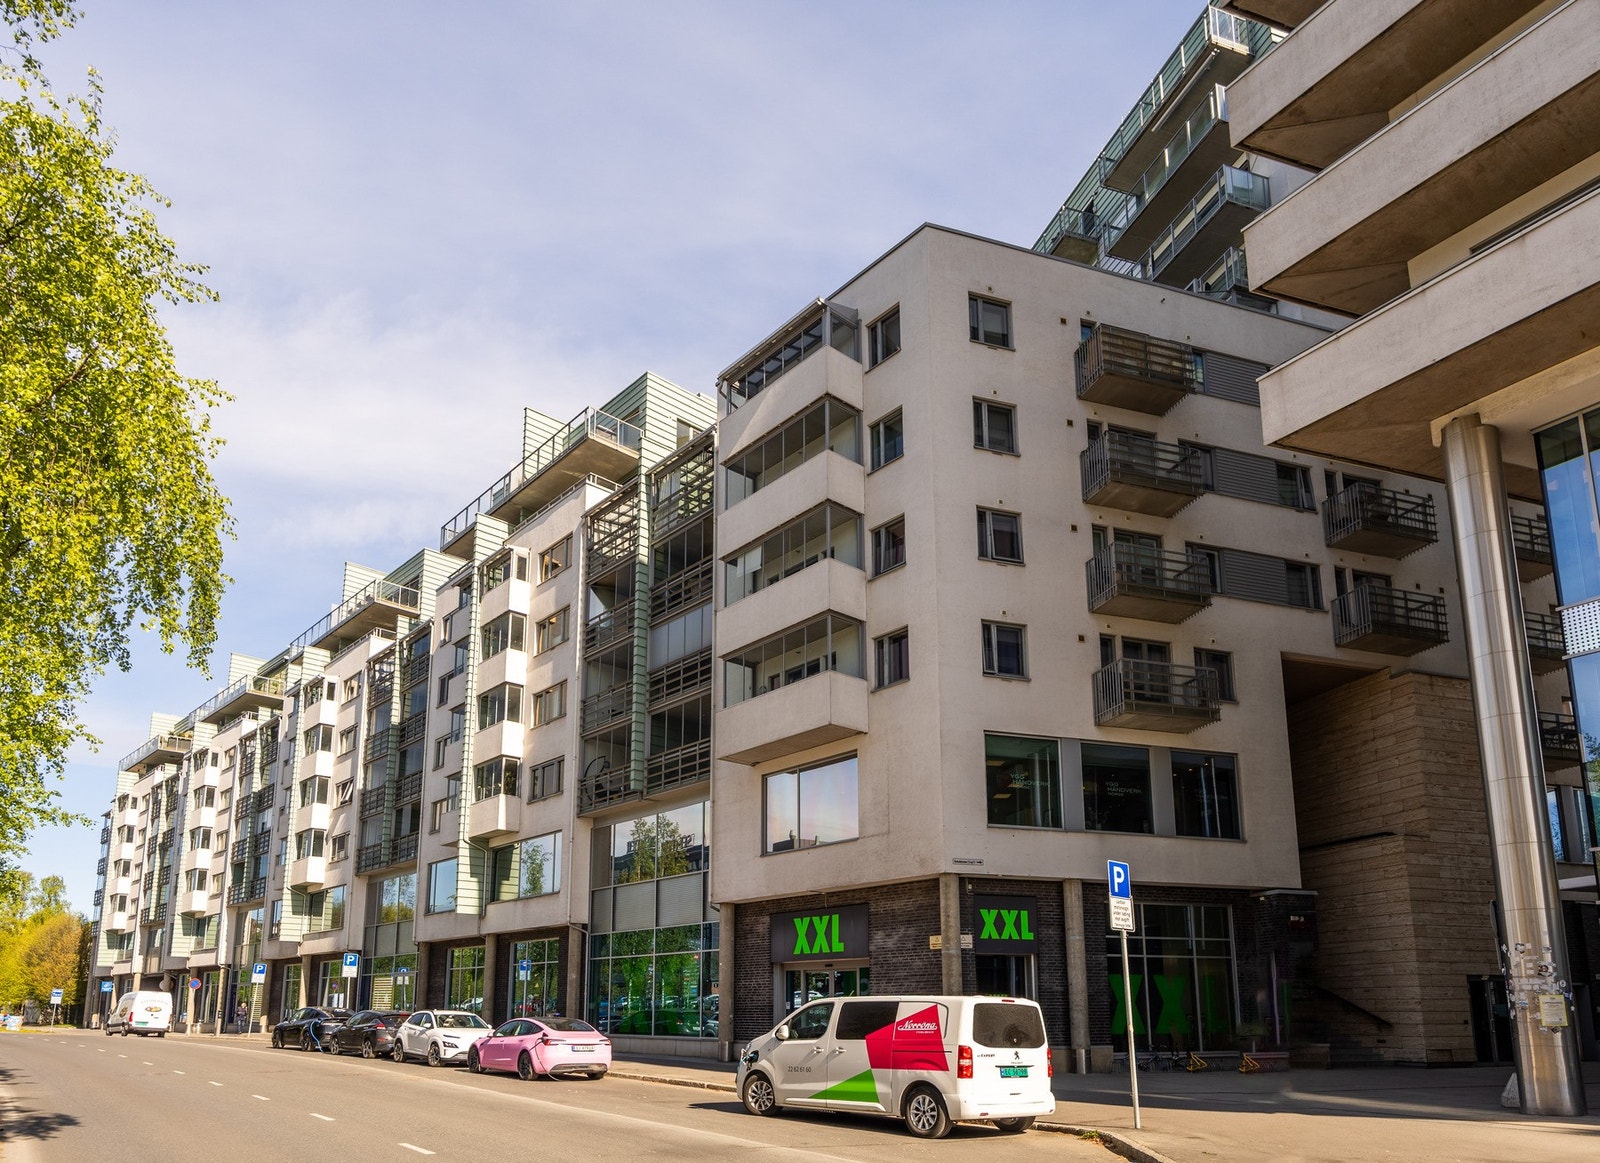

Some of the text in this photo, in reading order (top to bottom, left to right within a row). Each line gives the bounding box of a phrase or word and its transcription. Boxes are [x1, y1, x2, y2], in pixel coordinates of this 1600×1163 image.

[1113, 866, 1125, 892] P
[793, 914, 844, 955] XXL
[979, 908, 1034, 940] XXL
[256, 965, 264, 973] P
[347, 955, 354, 965] P
